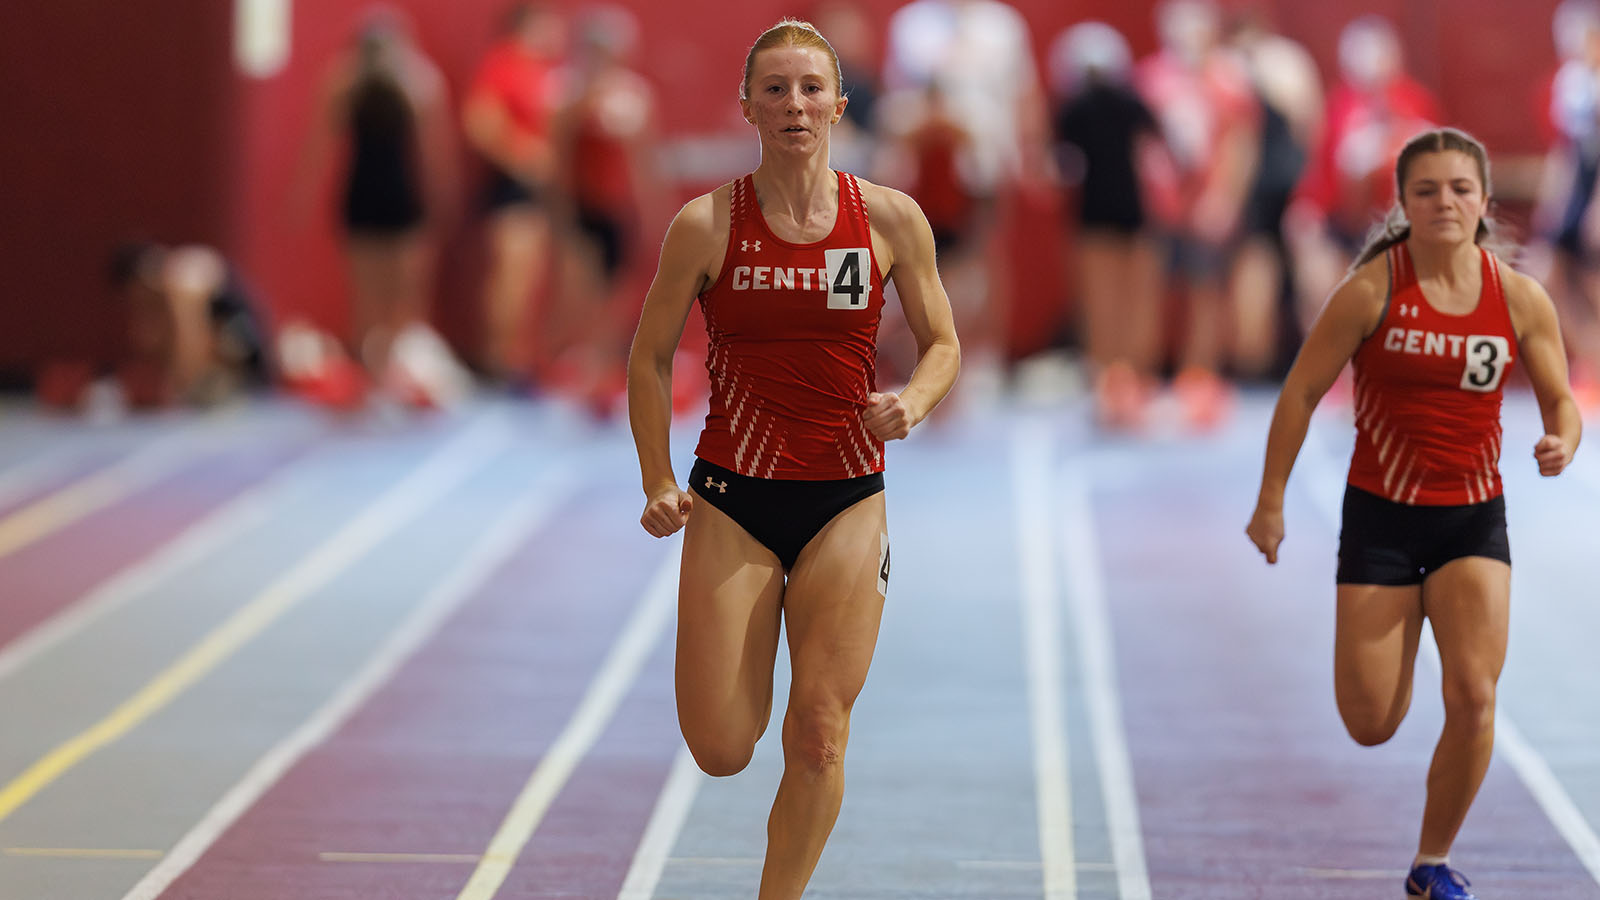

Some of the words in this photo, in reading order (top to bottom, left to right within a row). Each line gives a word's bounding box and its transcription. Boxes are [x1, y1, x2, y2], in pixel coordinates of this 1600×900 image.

[732, 266, 873, 291] CENT
[833, 252, 864, 305] 4
[1384, 327, 1512, 362] CENT
[1468, 341, 1498, 387] 3
